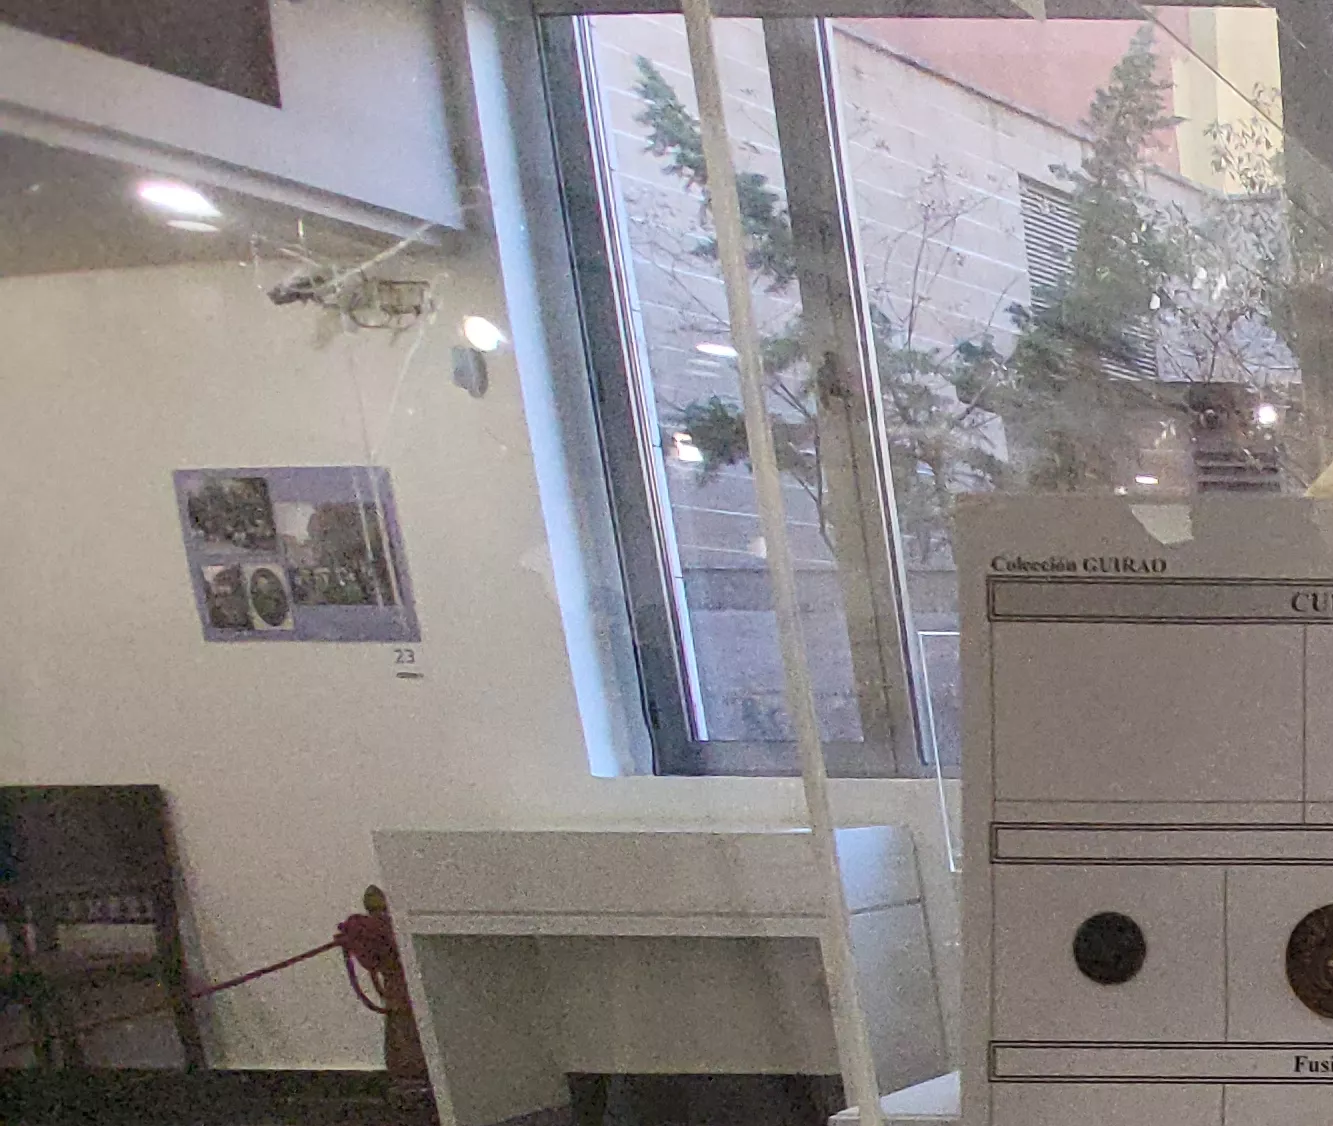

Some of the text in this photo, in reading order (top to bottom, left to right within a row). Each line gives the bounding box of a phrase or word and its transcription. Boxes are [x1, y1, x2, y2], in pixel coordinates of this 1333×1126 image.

[991, 556, 1168, 574] Colección GUIRAO
[393, 648, 416, 664] 23
